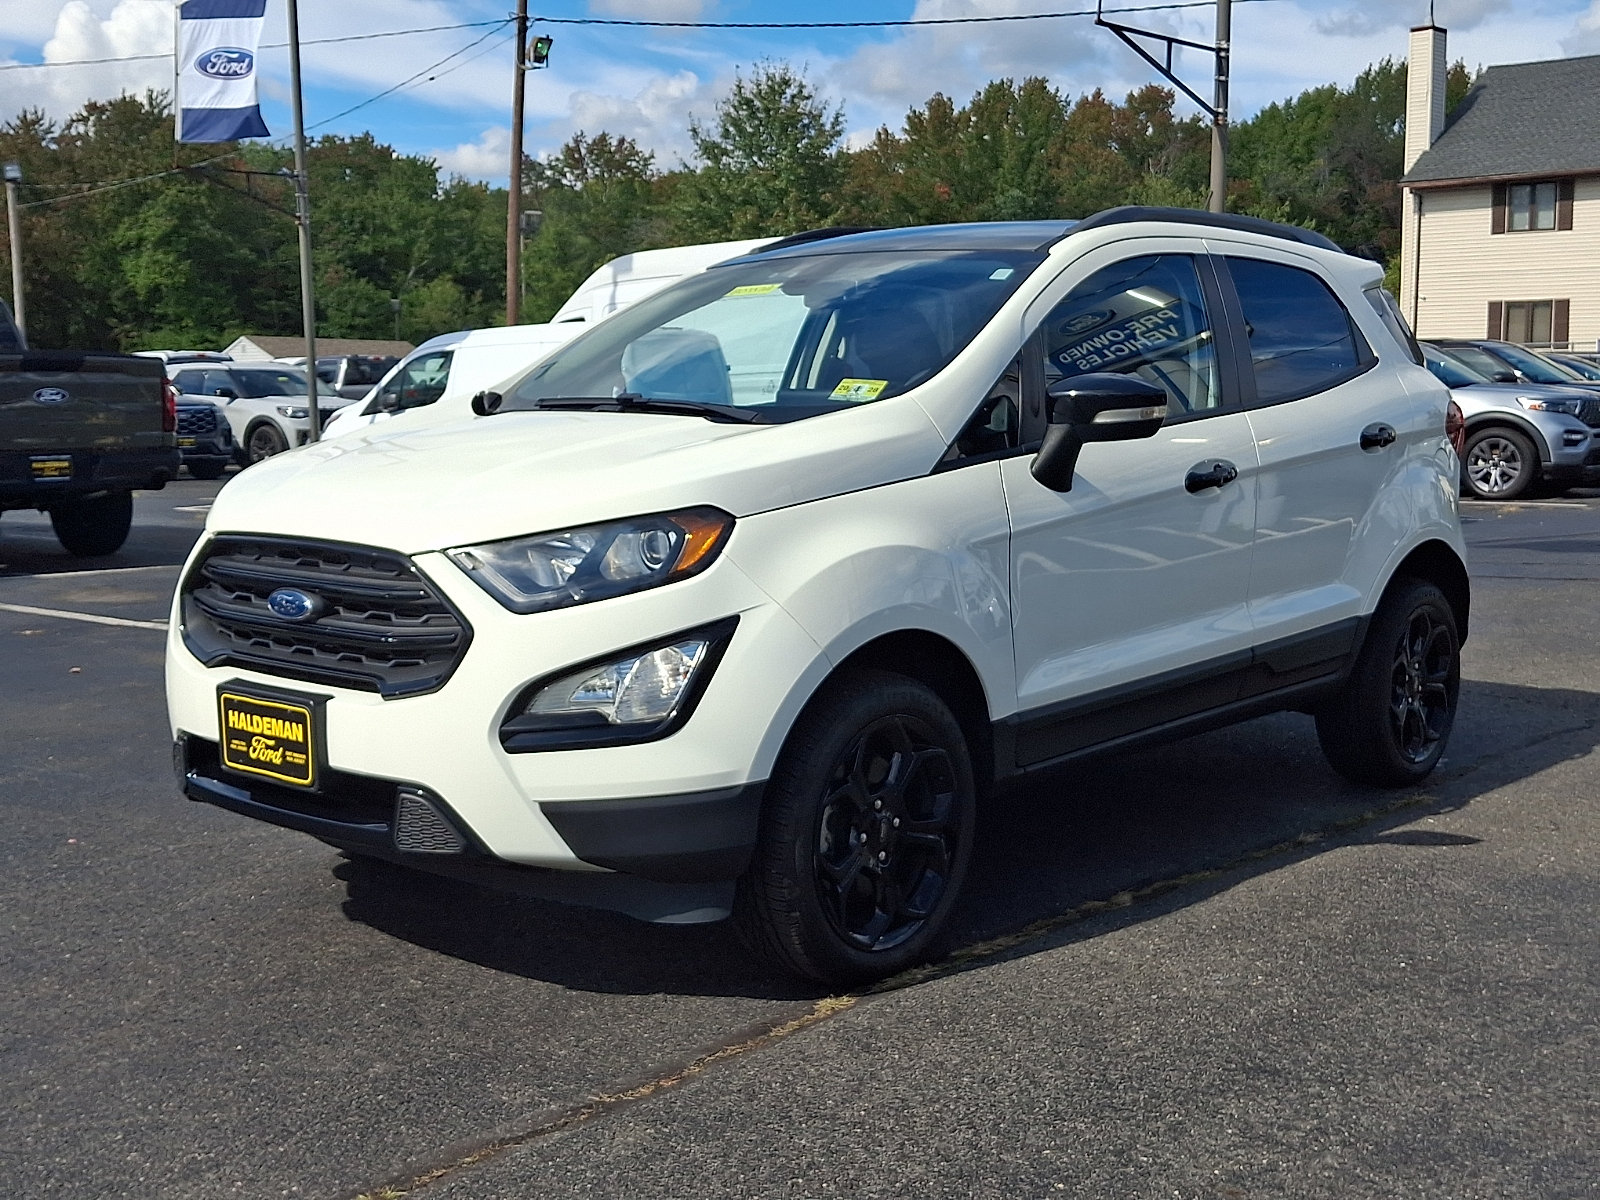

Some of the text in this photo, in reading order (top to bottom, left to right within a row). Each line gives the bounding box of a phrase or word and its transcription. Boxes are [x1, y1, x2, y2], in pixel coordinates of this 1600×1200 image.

[206, 51, 251, 75] Ford
[228, 709, 304, 743] HALDEMAN
[249, 736, 284, 765] Ford
